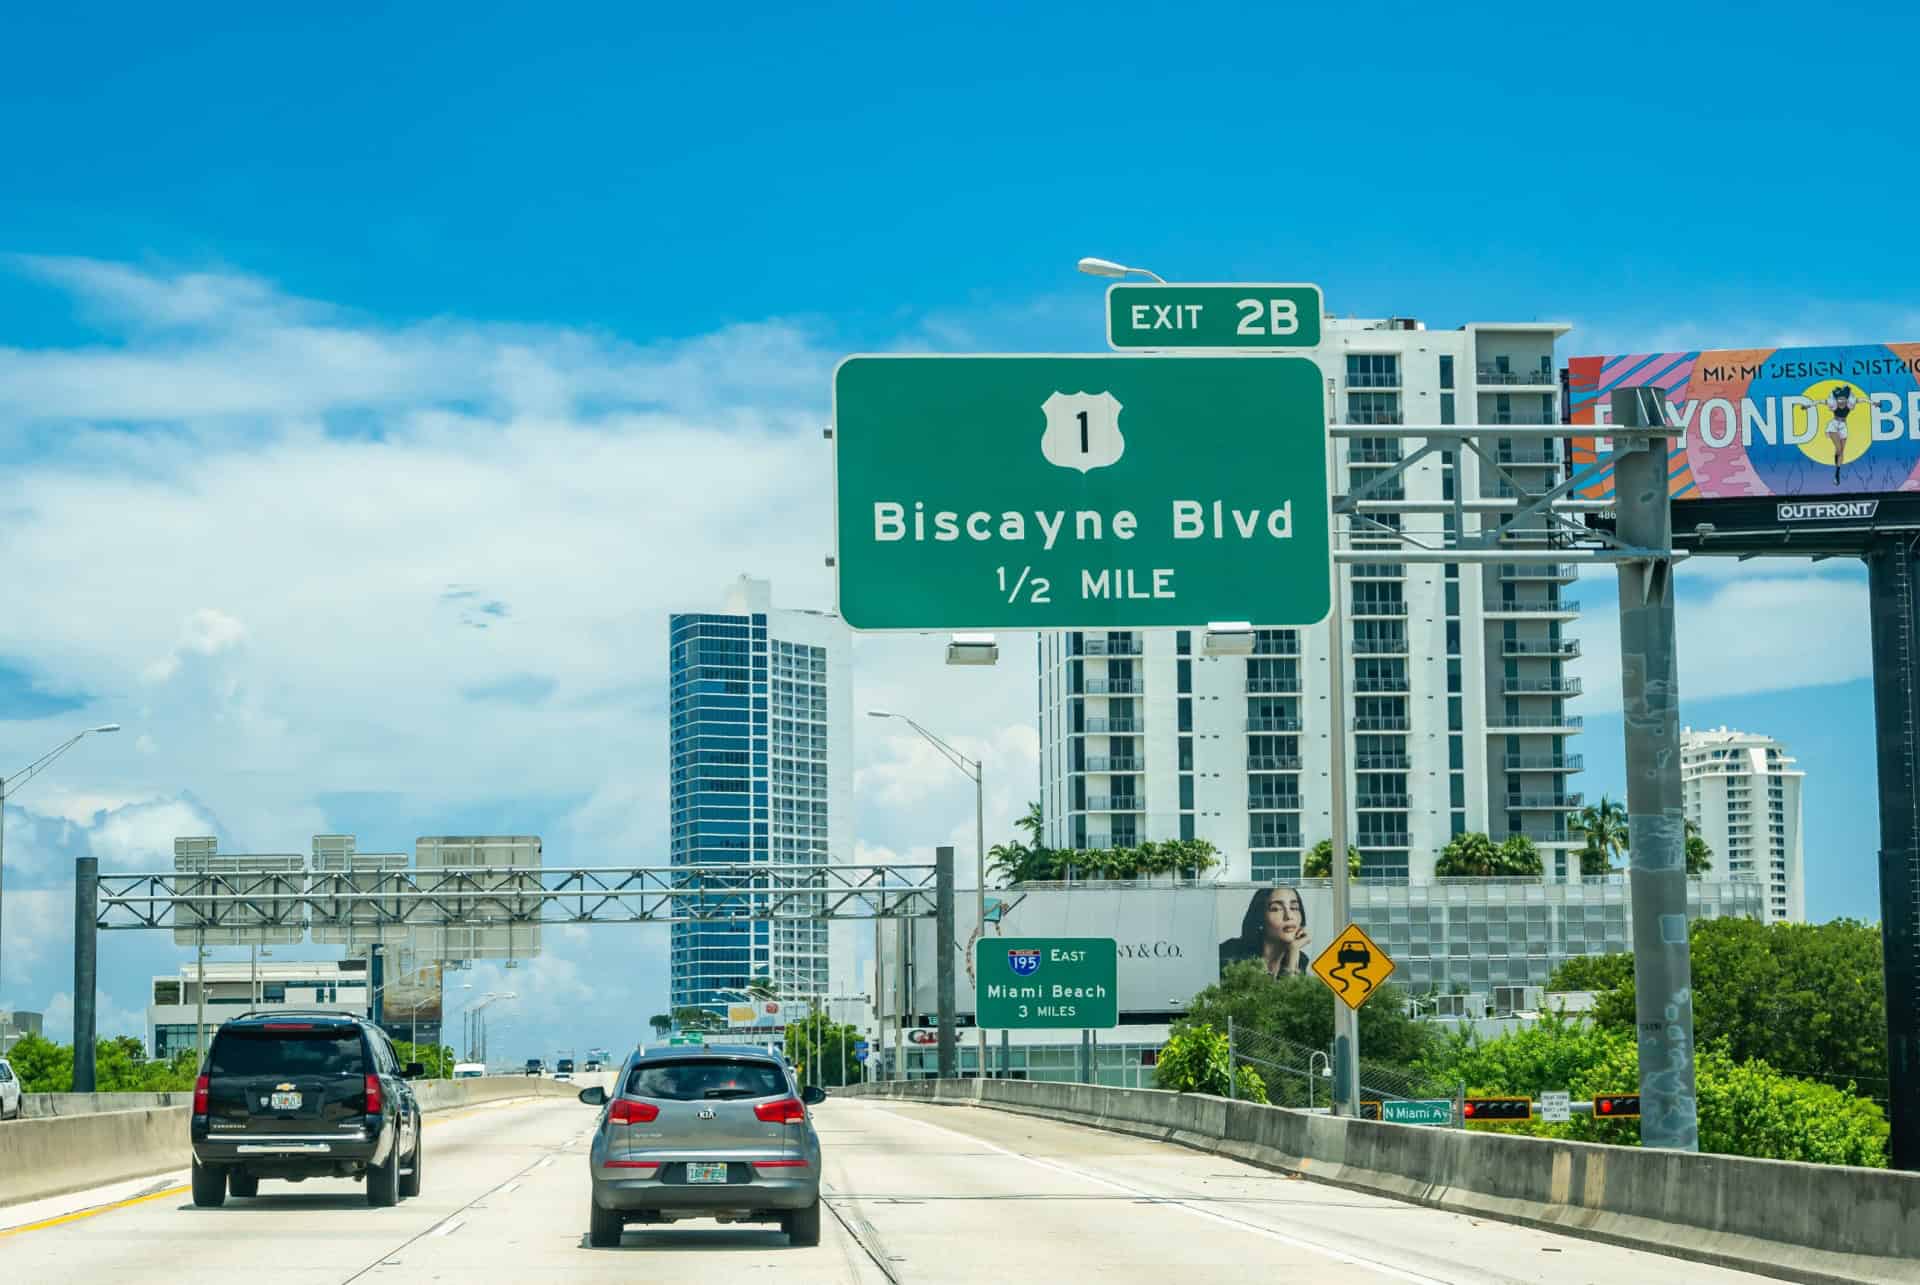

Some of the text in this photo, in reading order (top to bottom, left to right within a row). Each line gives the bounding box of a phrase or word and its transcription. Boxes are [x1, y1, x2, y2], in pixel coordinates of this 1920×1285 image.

[1131, 299, 1299, 335] EXIT 2B
[1703, 366, 1763, 382] MIAMI
[1772, 361, 1844, 379] DESIGN
[1076, 410, 1089, 454] 1
[1780, 502, 1873, 518] OUTFRONT
[874, 500, 1293, 550] Biscayne Blvd
[996, 566, 1176, 603] 1/2 MILE
[1013, 948, 1086, 969] 195 EAST
[988, 984, 1106, 998] Miami Beach
[1018, 1005, 1076, 1018] 3 MILES
[699, 1110, 714, 1120] KIA
[1385, 1107, 1394, 1119] N
[1396, 1107, 1430, 1119] Miami
